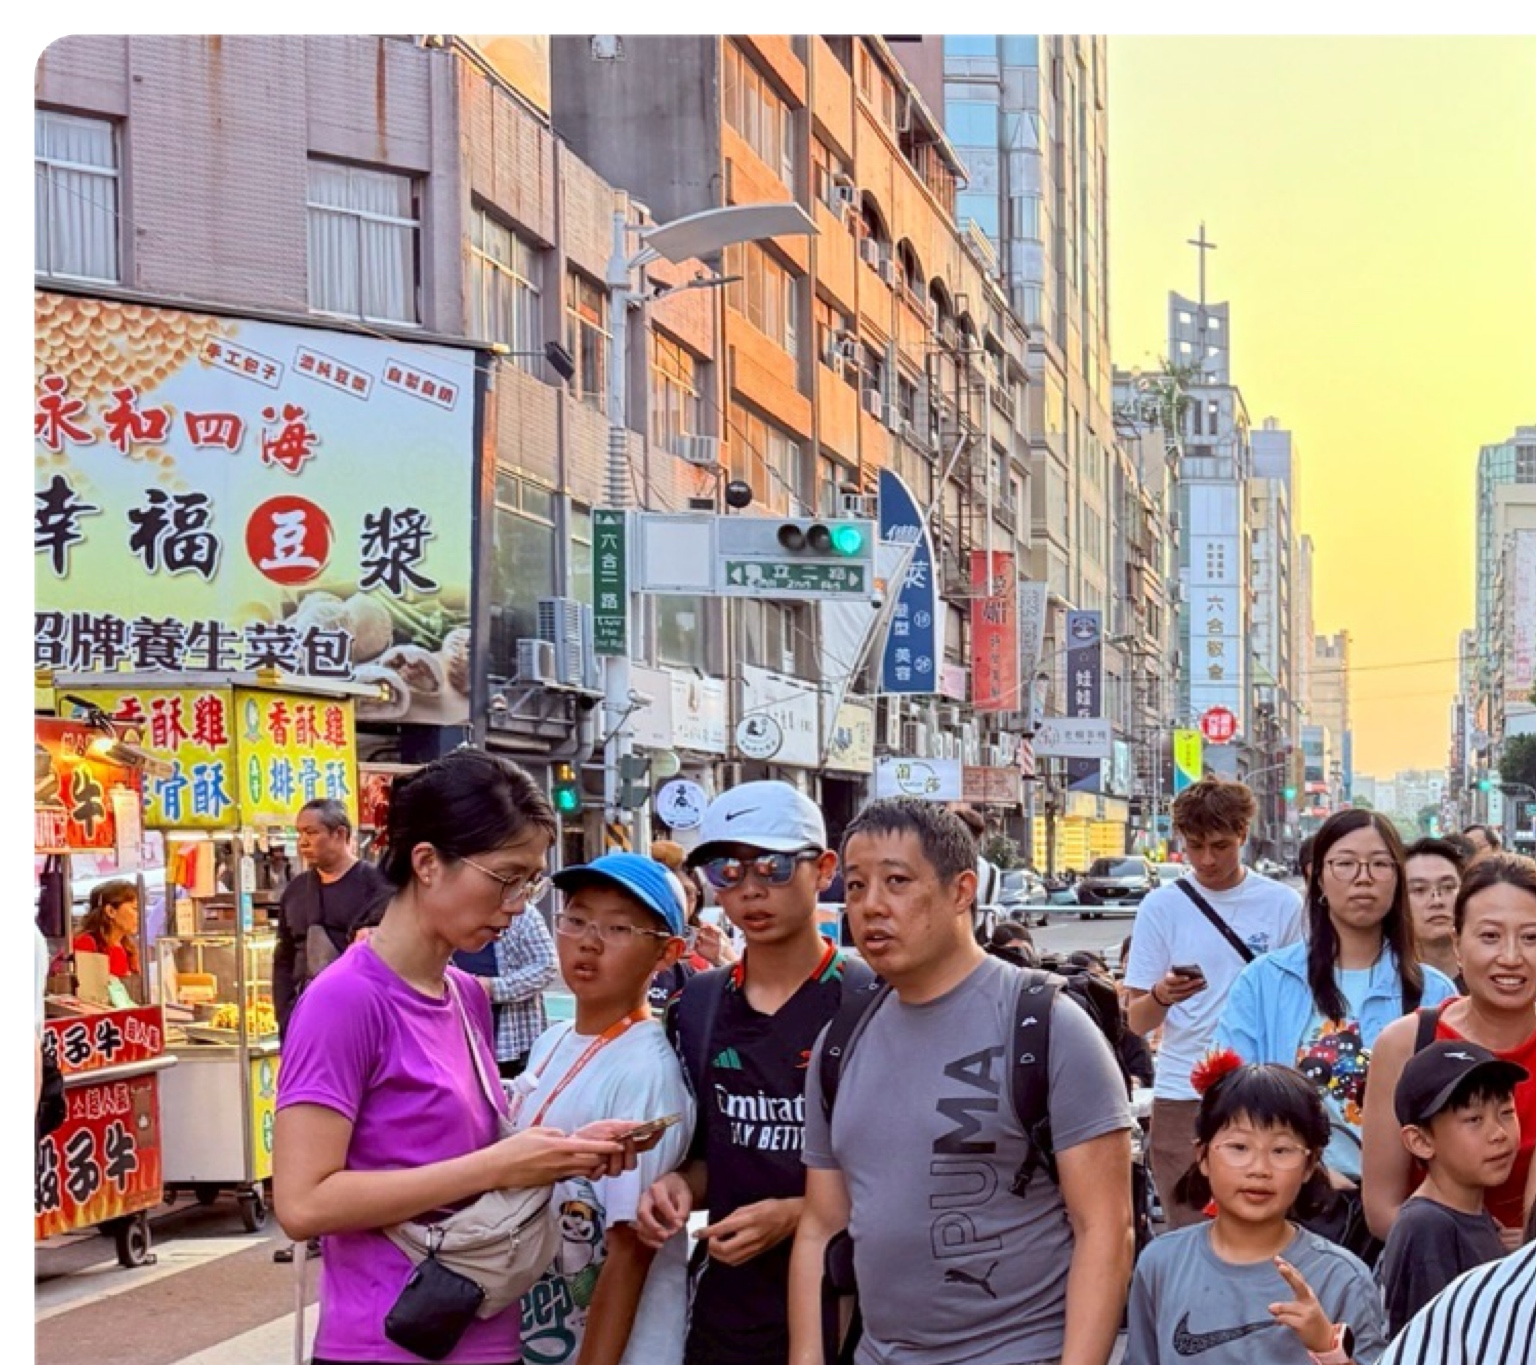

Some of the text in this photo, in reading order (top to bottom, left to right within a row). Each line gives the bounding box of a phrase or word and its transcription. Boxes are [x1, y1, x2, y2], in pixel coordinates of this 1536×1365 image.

[206, 342, 277, 380] 手工包子
[35, 376, 318, 470] 永和四海
[35, 475, 438, 594] 幸福豆漿
[600, 533, 618, 609] 六合二路
[138, 762, 231, 820] 骨酥
[930, 1045, 1005, 1259] PUMA
